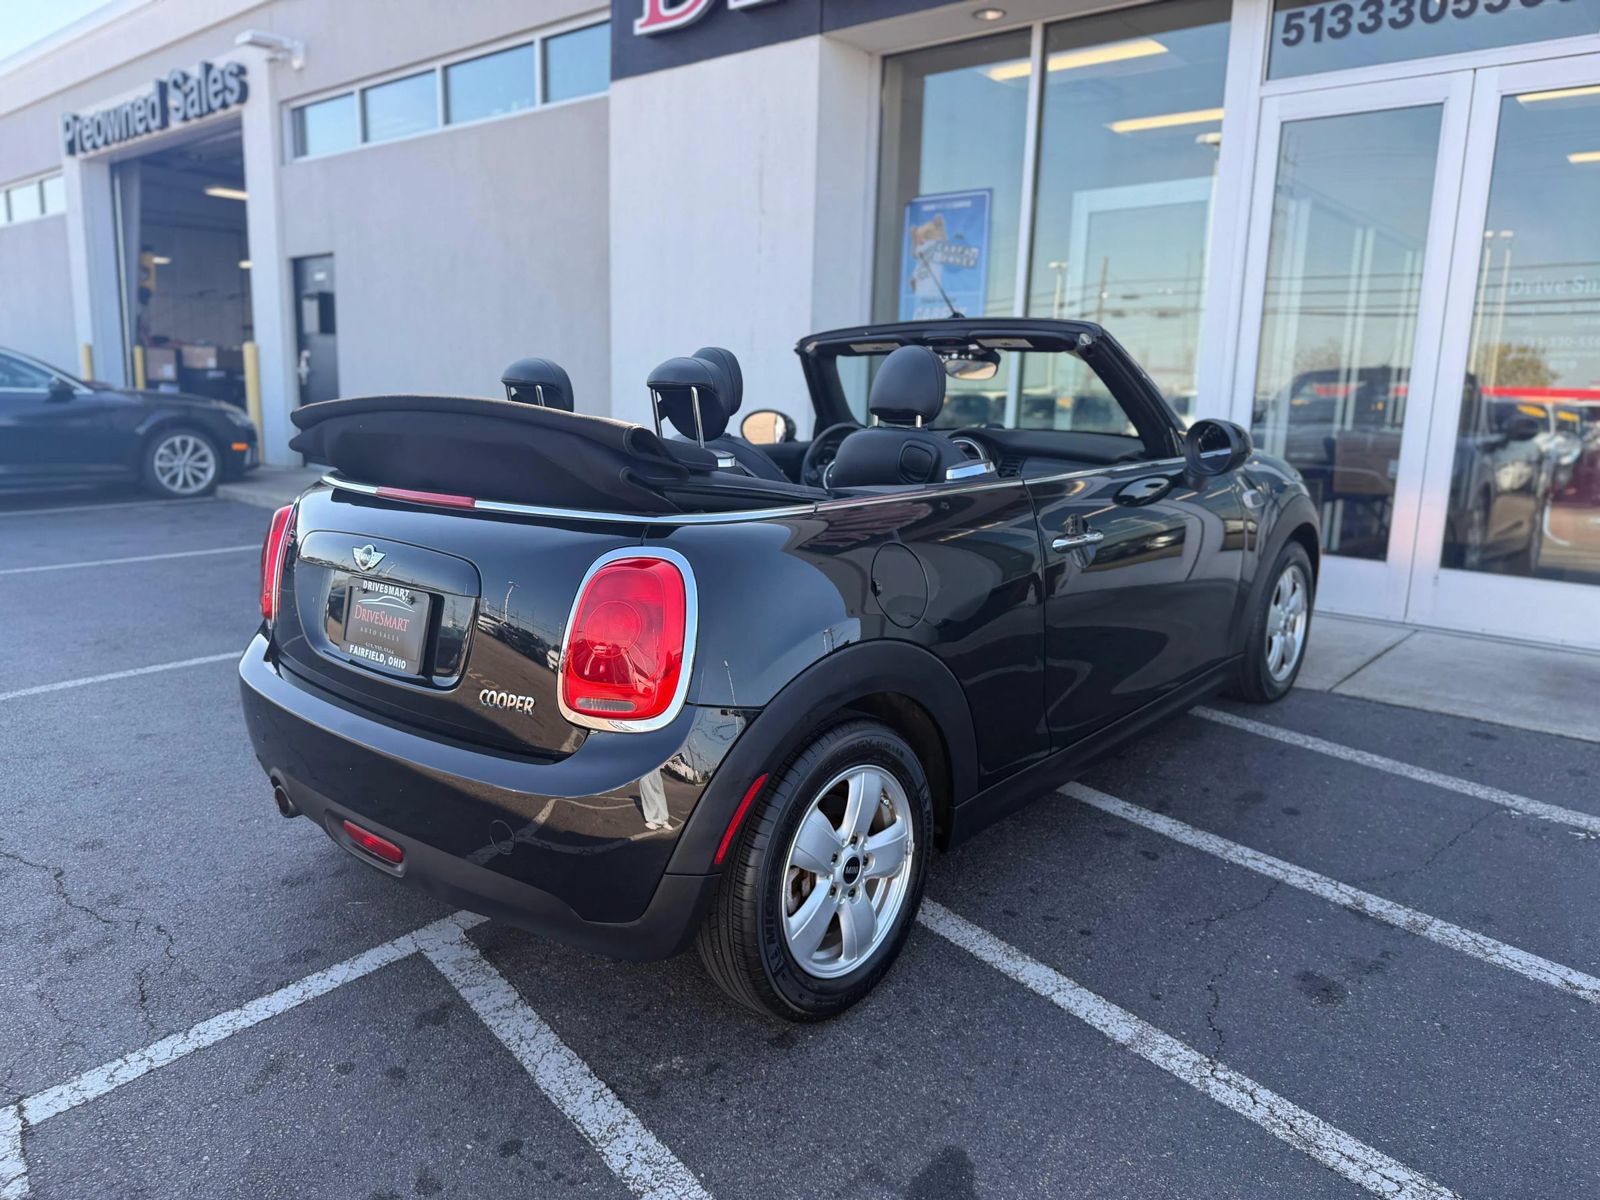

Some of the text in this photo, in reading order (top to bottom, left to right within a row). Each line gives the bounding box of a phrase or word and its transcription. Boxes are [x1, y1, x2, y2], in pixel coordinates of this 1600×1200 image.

[62, 60, 248, 156] Preowned Sales
[362, 580, 410, 600] DRIVESMART
[349, 644, 386, 666] FAIRFIELD,
[388, 656, 407, 670] OHIO
[479, 688, 535, 715] COOPER
